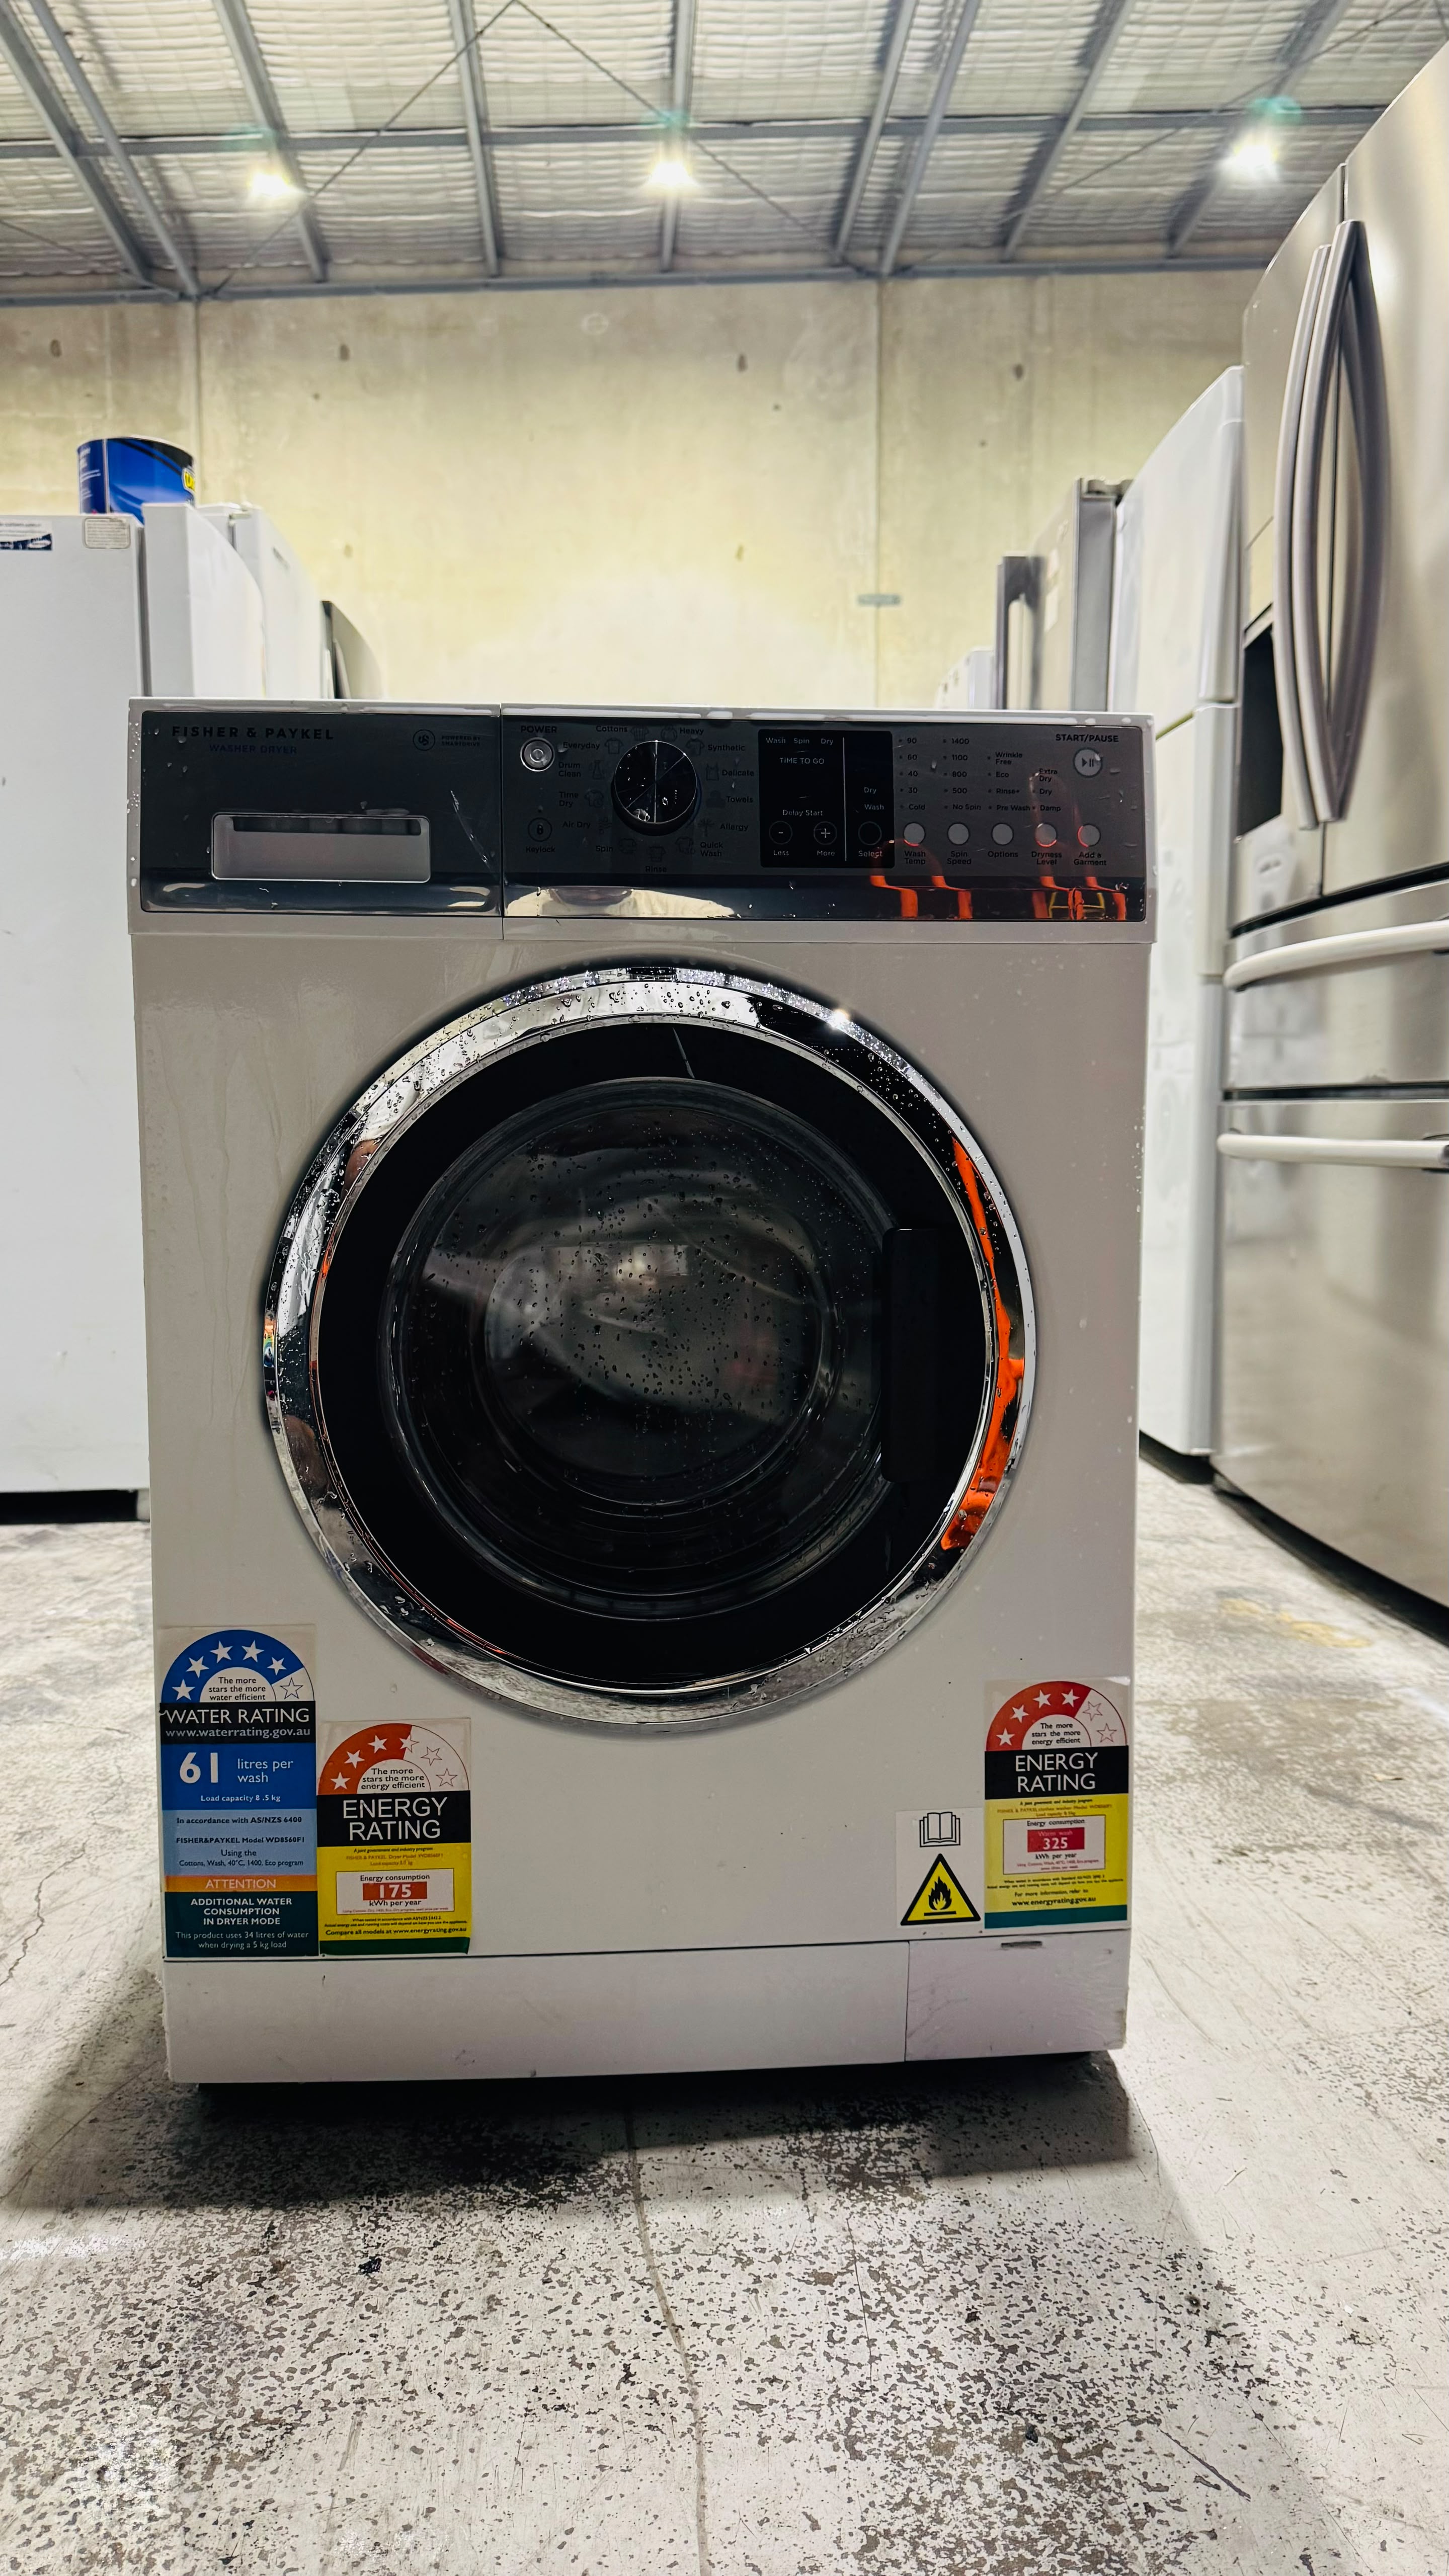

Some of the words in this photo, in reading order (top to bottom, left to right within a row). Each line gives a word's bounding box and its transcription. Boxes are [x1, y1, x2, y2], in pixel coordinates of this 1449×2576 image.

[172, 726, 238, 737] FISHER
[247, 727, 256, 737] &
[265, 728, 334, 740] PAYKEL
[596, 725, 627, 733] Cottons
[680, 727, 704, 736] Heavy
[1056, 734, 1118, 742] START/PAUSE
[210, 744, 255, 752] WASHER
[261, 745, 297, 754] DRYER
[563, 742, 600, 750] Everyday
[708, 743, 745, 752] Synthetic
[722, 769, 754, 777] Delicate
[559, 799, 573, 808] Dry
[562, 821, 575, 829] Air
[577, 821, 590, 830] Dry
[720, 823, 748, 832] Allergy
[526, 846, 555, 854] Keylock
[596, 845, 613, 853] Spin
[166, 1710, 231, 1724] WATER
[238, 1709, 309, 1723] RATING
[166, 1728, 310, 1738] www.waterrating.gov.au
[237, 1758, 268, 1769] litres
[273, 1760, 293, 1772] per
[1015, 1752, 1098, 1772] ENERGY
[180, 1752, 218, 1784] 61
[237, 1772, 268, 1783] wash
[1018, 1774, 1095, 1792] RATING
[343, 1797, 447, 1818] ENERGY
[350, 1820, 440, 1840] RATING
[1043, 1837, 1068, 1849] 325
[221, 1849, 242, 1858] Using
[205, 1880, 276, 1889] ATTENTION
[380, 1884, 412, 1898] 175
[1012, 1897, 1096, 1906] www.energyrating.gov.au
[194, 1932, 223, 1940] product
[221, 1942, 244, 1950] drying
